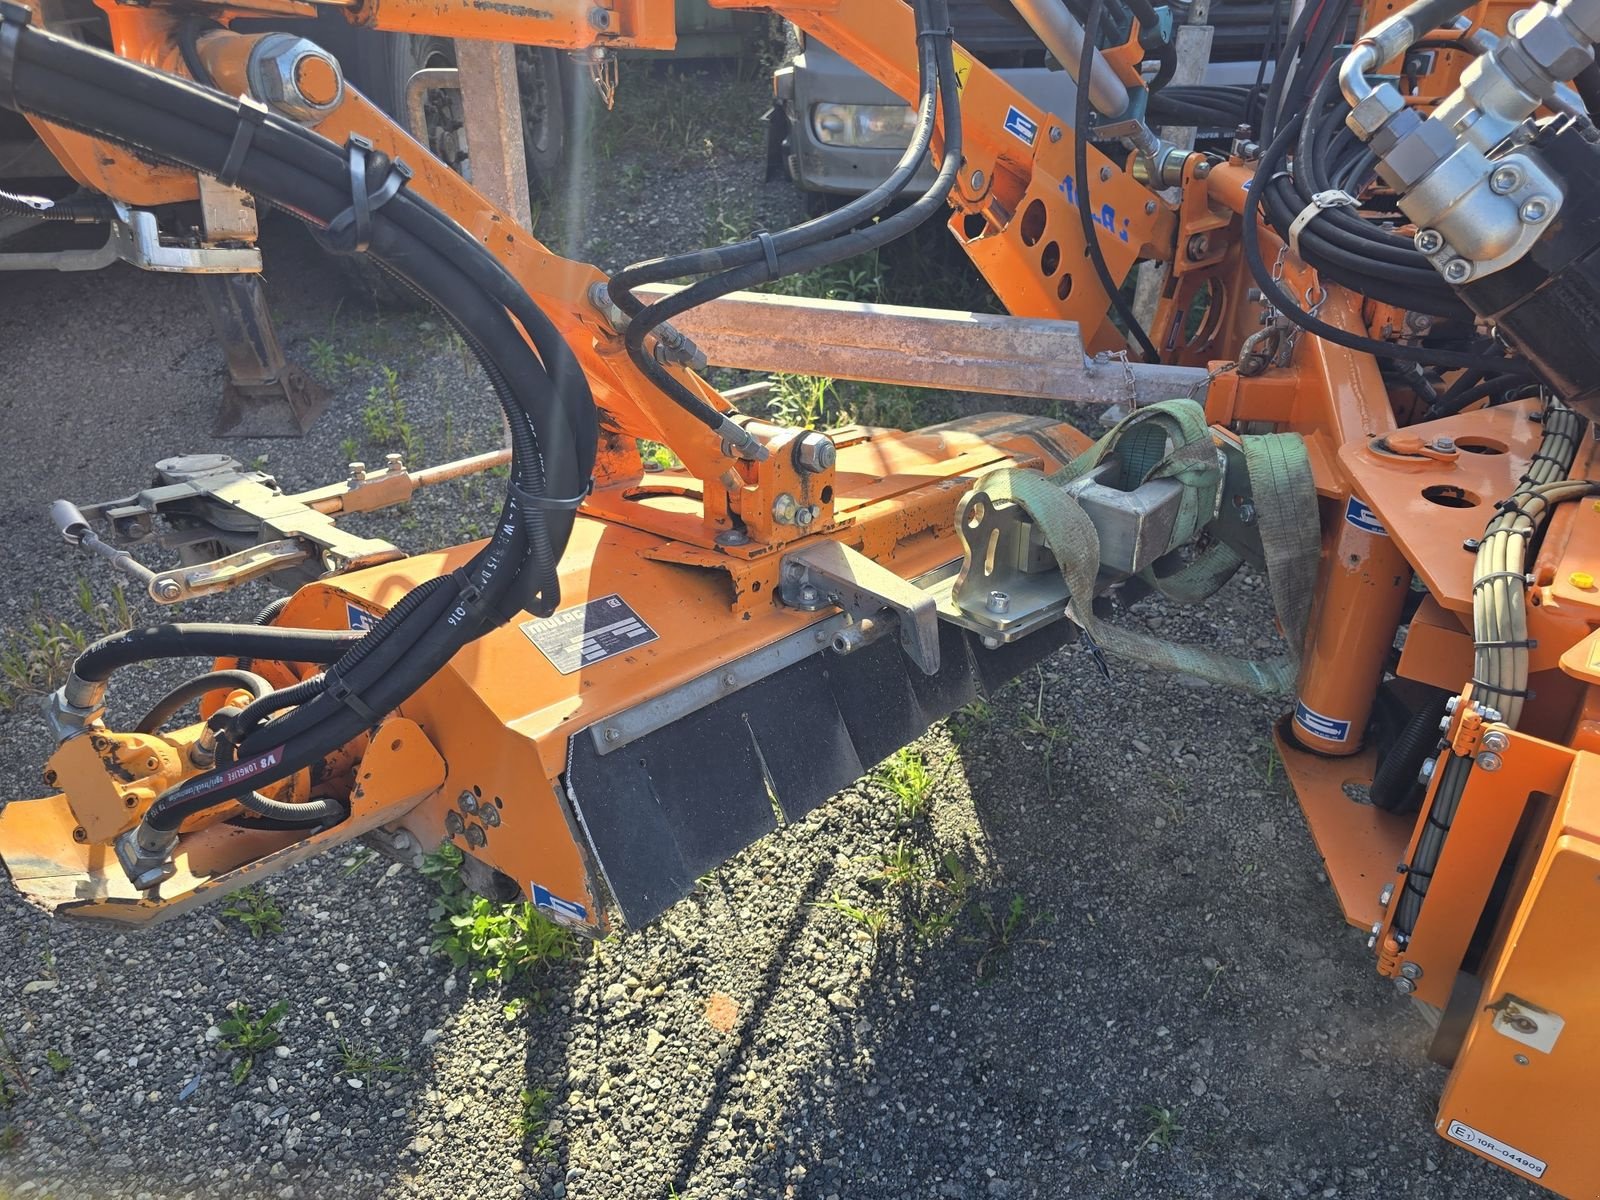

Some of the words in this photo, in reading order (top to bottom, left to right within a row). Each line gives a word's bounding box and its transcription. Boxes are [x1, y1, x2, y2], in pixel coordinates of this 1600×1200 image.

[527, 609, 586, 634] MULAG
[260, 754, 277, 769] V8
[227, 762, 258, 782] LONGLIFE
